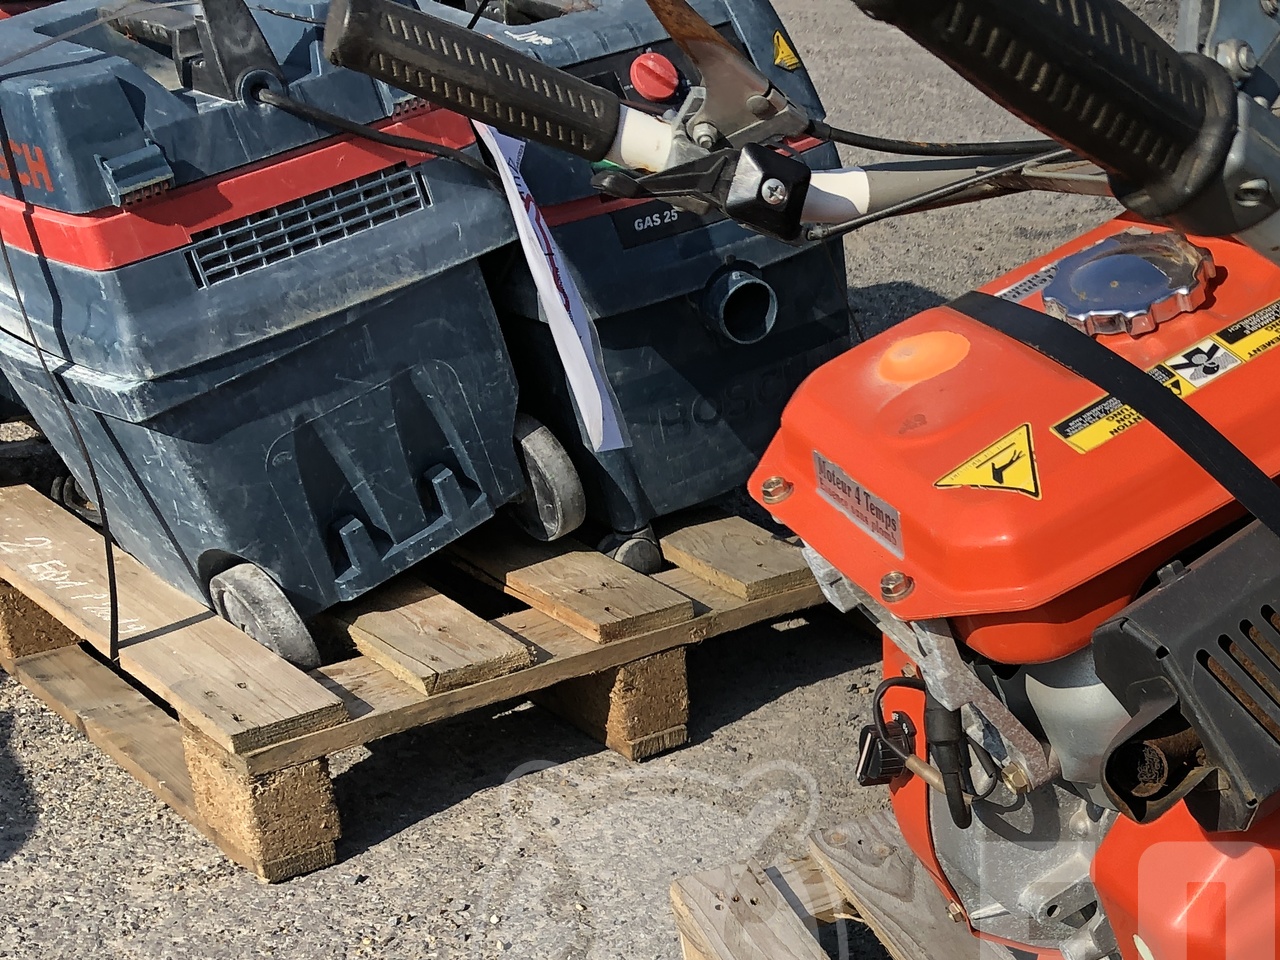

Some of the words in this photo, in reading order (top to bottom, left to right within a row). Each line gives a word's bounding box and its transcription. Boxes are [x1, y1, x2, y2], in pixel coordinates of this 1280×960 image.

[634, 213, 661, 231] GAS
[663, 209, 678, 224] 25
[1109, 414, 1143, 435] NTION
[817, 456, 853, 497] Moteur
[854, 486, 862, 504] 4
[864, 491, 898, 531] Temps
